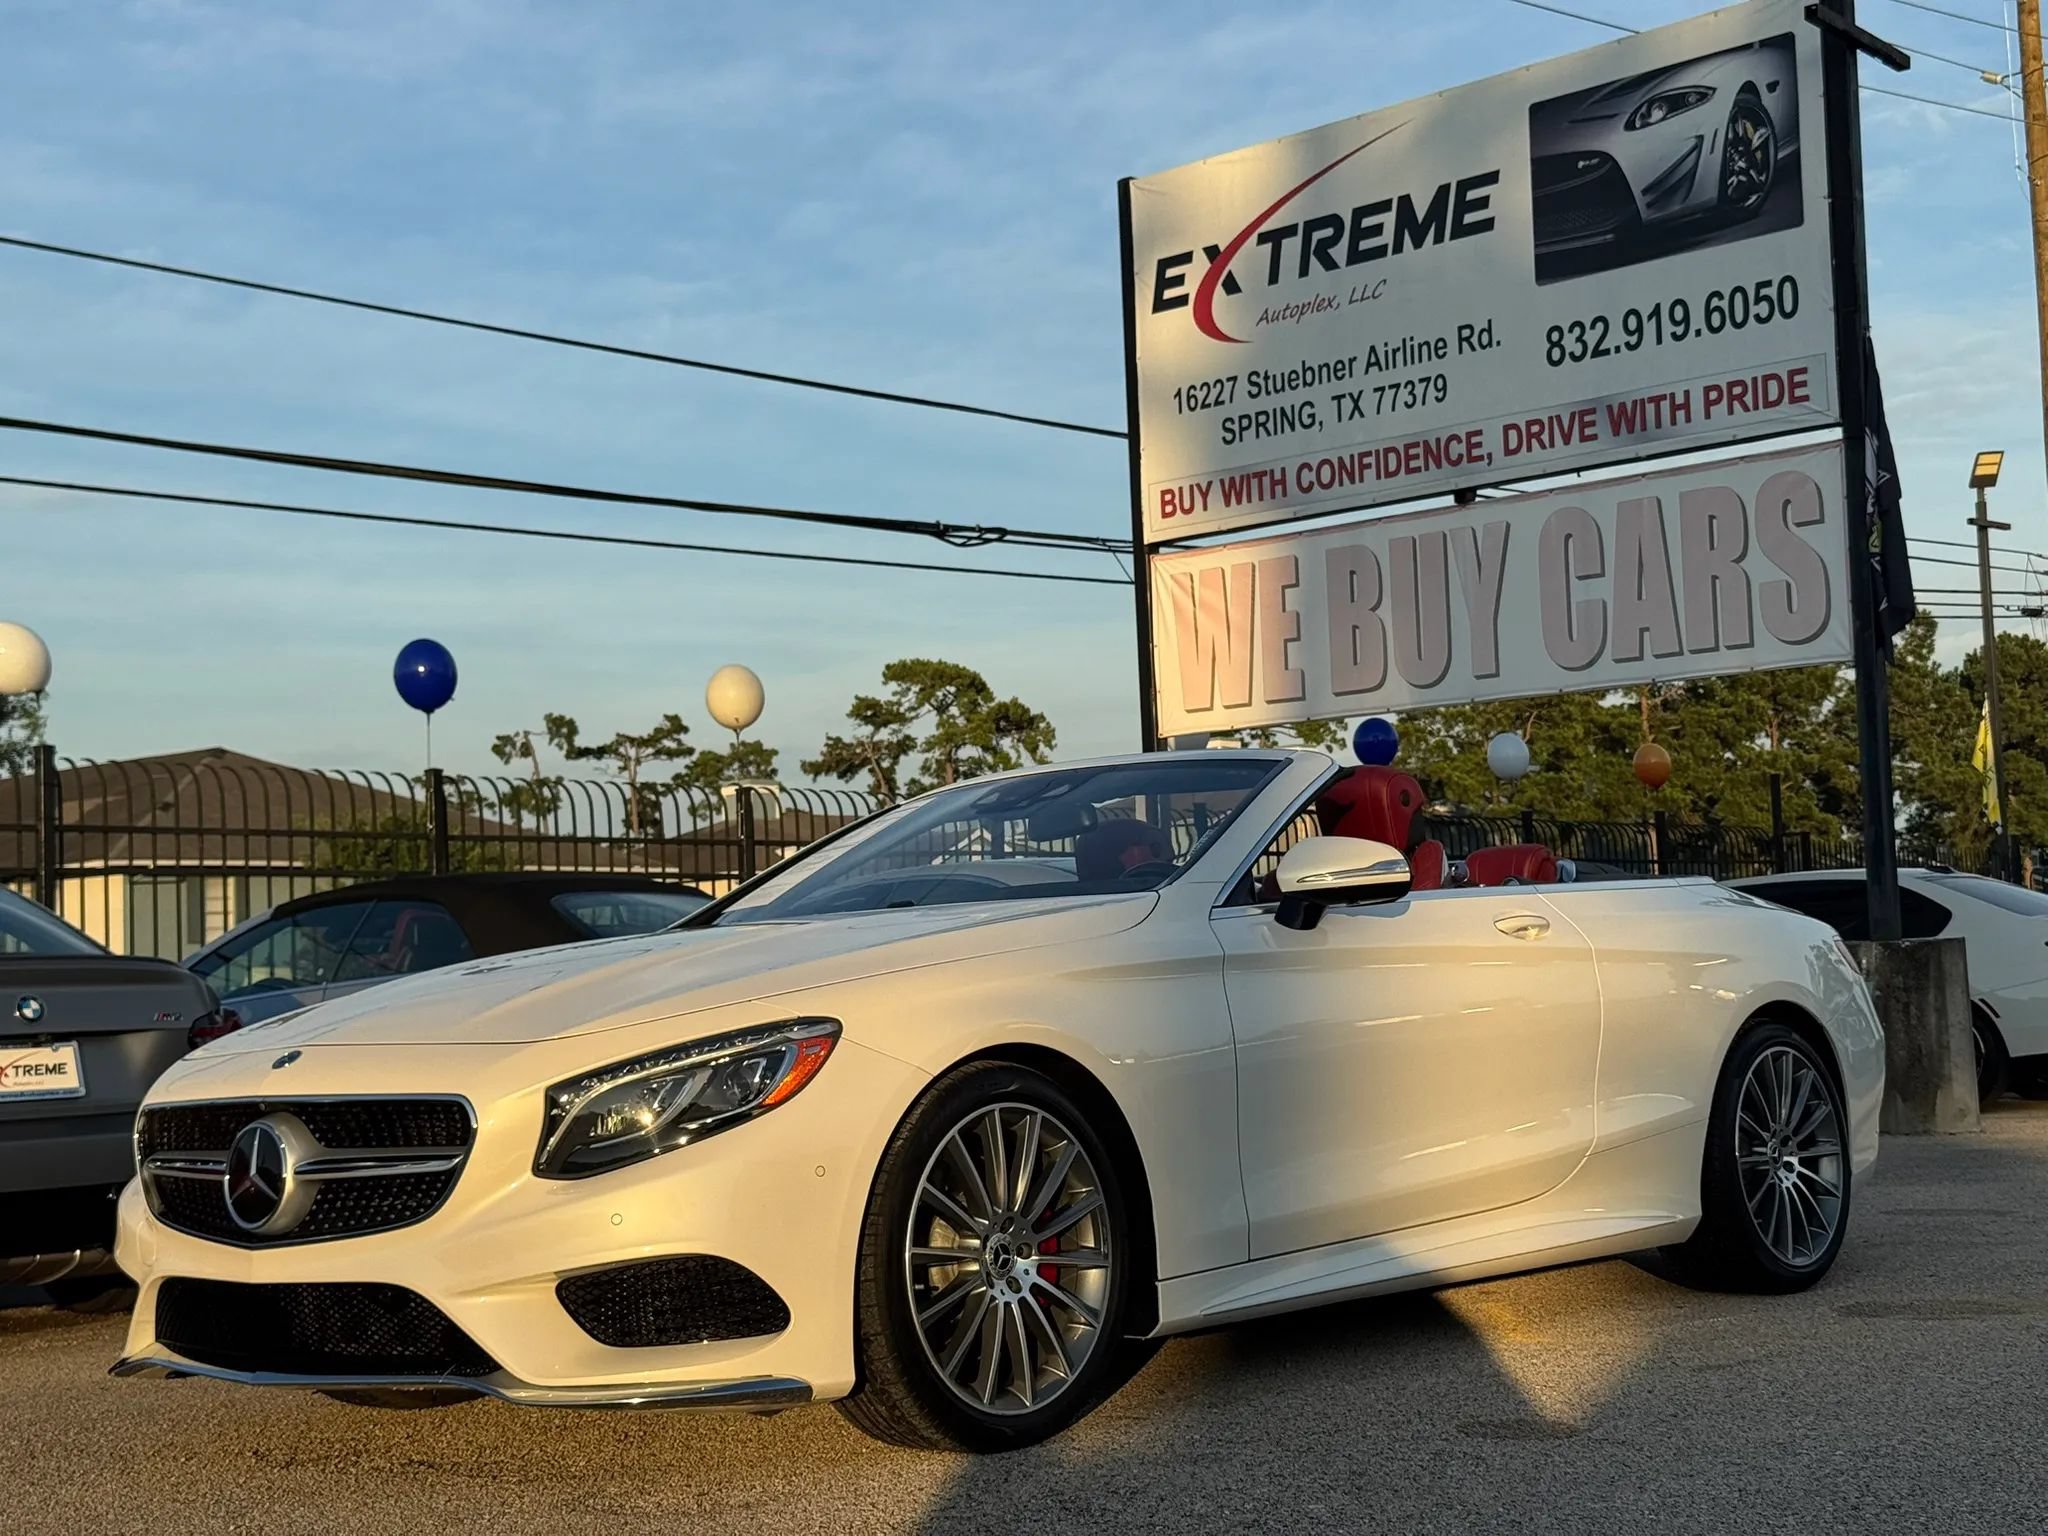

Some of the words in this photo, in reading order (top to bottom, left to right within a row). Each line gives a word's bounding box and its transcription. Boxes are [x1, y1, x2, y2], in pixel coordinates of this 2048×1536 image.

[1152, 169, 1500, 315] EXTREME
[1255, 293, 1341, 327] Autoplex,
[1348, 278, 1388, 305] LLC
[1545, 274, 1799, 367] 832.919.6050
[1173, 376, 1238, 415] 16227
[1247, 354, 1358, 400] Stuebner
[1364, 336, 1448, 375] Airline
[1457, 319, 1502, 355] Rd.
[1221, 400, 1324, 446] SPRING,
[1331, 390, 1365, 424] TX
[1373, 373, 1448, 417] 77379
[1160, 480, 1213, 519] BUY
[1219, 467, 1288, 508] WITH
[1296, 429, 1493, 494] CONFIDENCE,
[1502, 407, 1598, 457] DRIVE
[1606, 390, 1691, 437] WITH
[1703, 367, 1810, 420] PRIDE
[1171, 554, 1305, 714] WE
[1325, 520, 1511, 697] BUY
[1538, 470, 1832, 672] CARS
